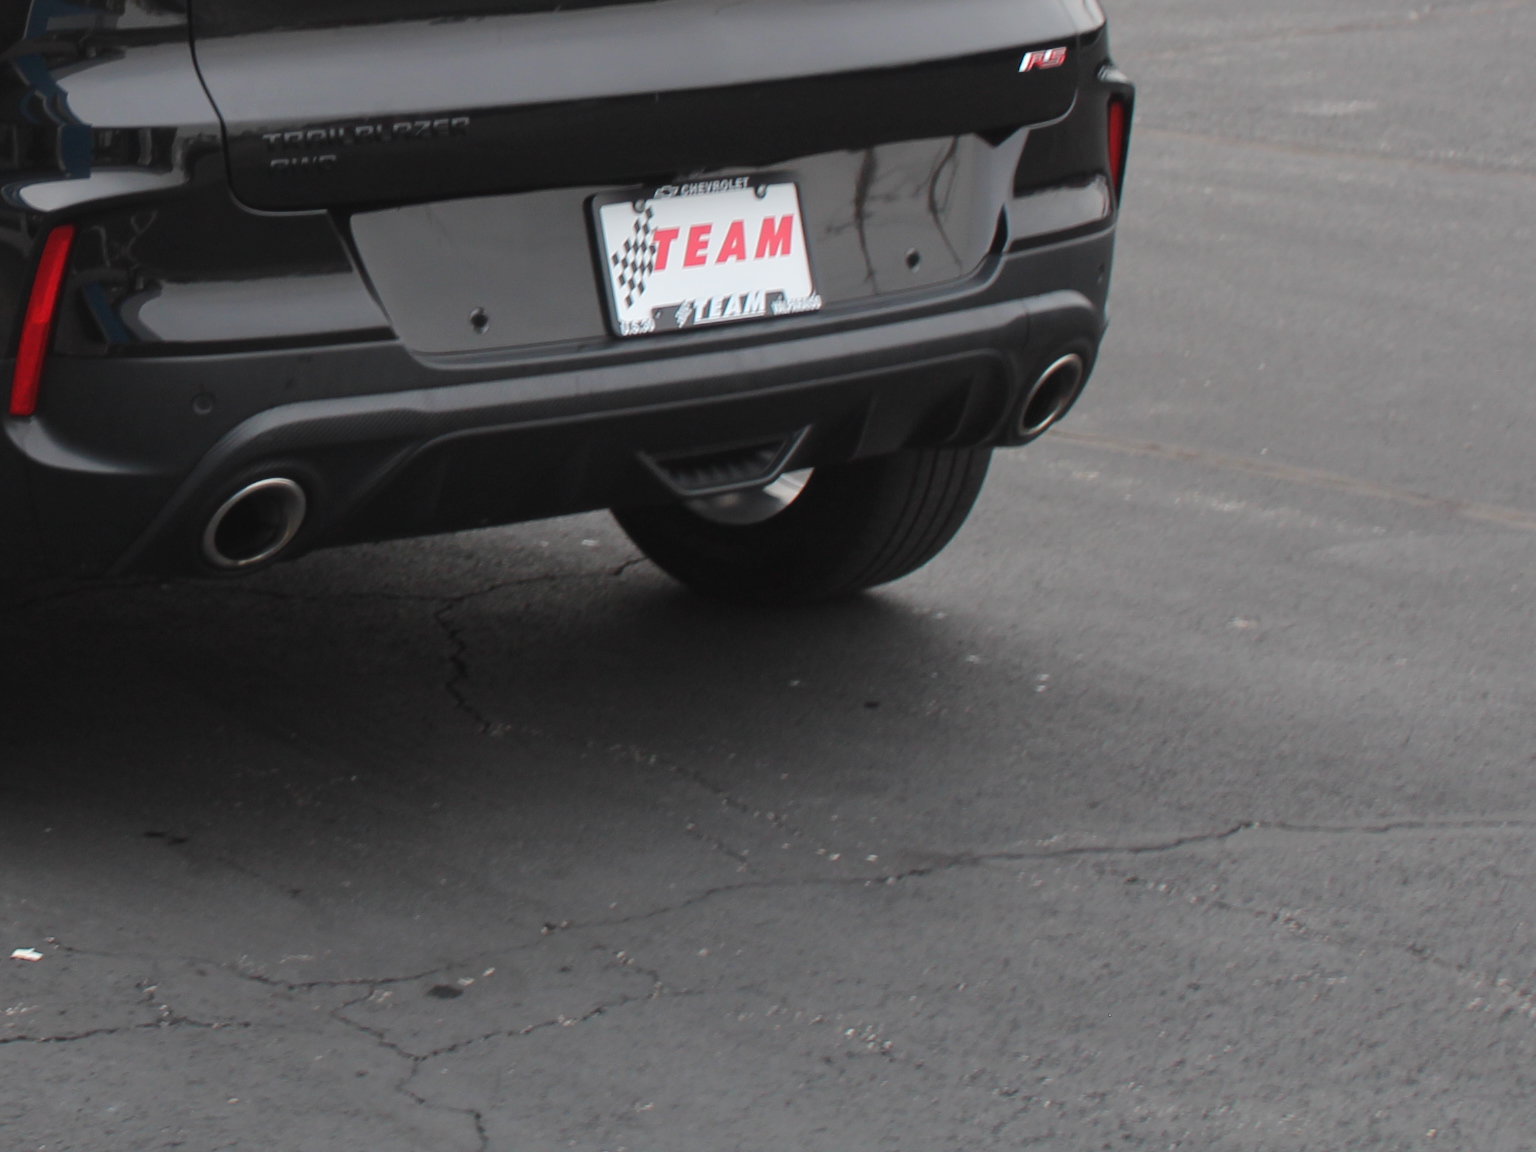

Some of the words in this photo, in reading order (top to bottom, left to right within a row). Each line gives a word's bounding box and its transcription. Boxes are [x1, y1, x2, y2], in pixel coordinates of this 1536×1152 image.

[680, 176, 750, 197] CHEVROLET
[652, 214, 794, 271] TEAM
[693, 291, 766, 324] TEAM
